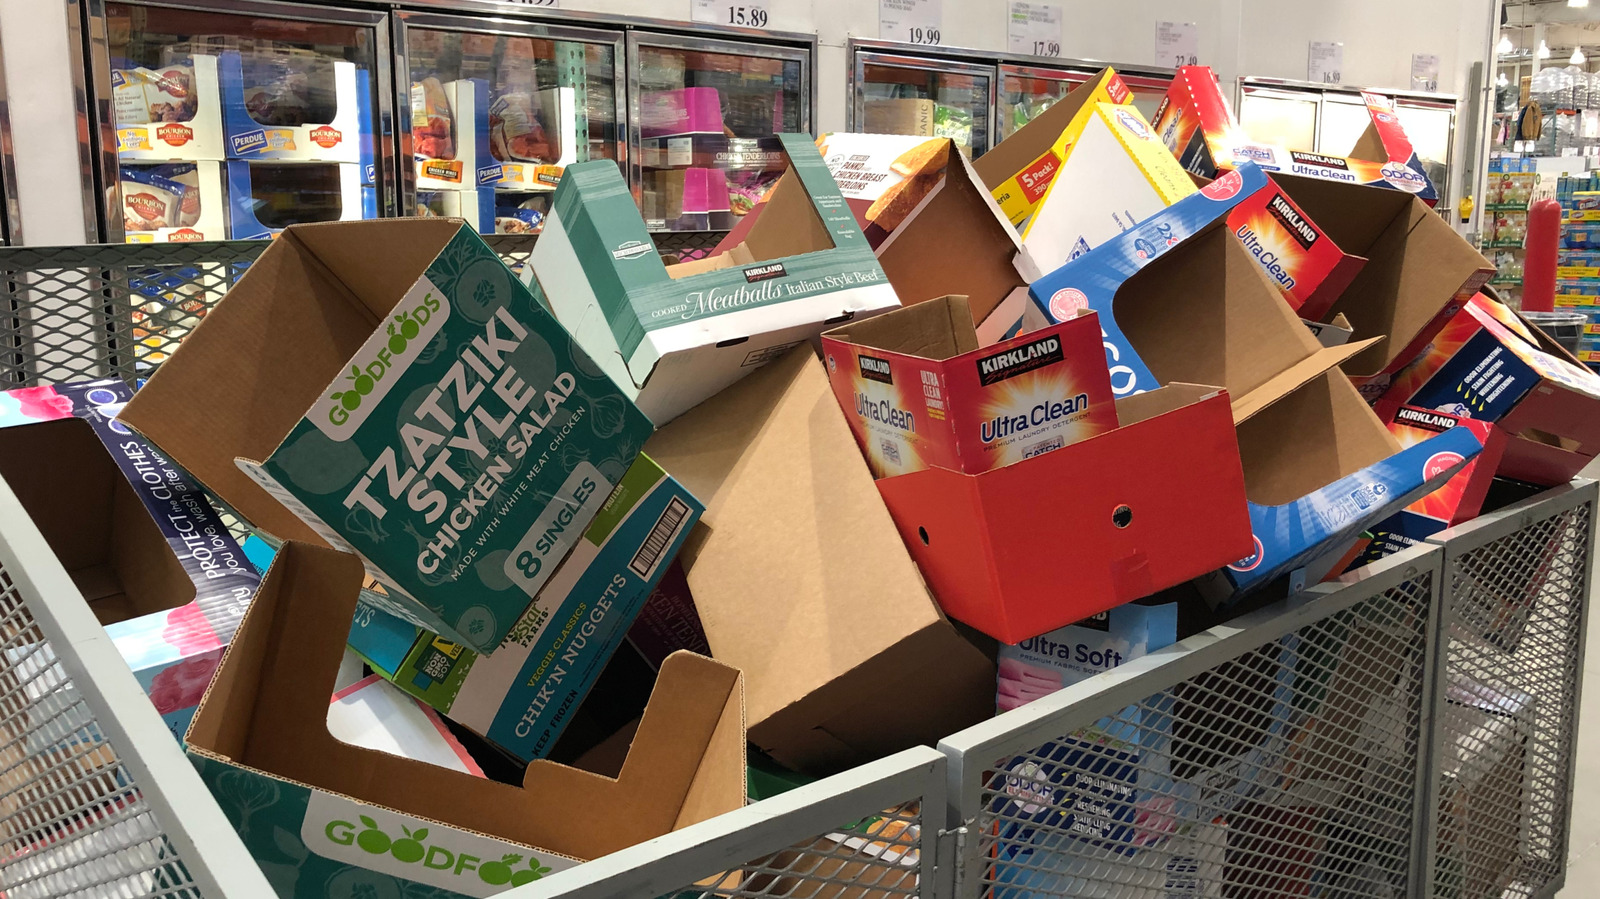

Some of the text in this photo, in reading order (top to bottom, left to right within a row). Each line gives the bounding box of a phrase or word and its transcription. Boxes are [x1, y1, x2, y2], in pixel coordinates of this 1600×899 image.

[728, 6, 768, 27] 15.89
[909, 27, 941, 45] 19.99
[1033, 41, 1060, 57] 17.99
[158, 127, 192, 135] BOURBON
[234, 132, 264, 147] PERDUE
[480, 167, 502, 177] PERDUE
[1293, 152, 1345, 166] KIRKLAND
[834, 170, 888, 182] CHICKEN BREAST
[1022, 162, 1054, 188] 5 Pack!
[1291, 165, 1355, 181] Ultra Clean
[1381, 168, 1424, 182] ODOR
[127, 196, 165, 211] BOURBON
[1272, 196, 1317, 242] KIRKLAND
[1236, 224, 1296, 291] Ultra Clean
[745, 264, 783, 278] KIRKLAND
[651, 268, 879, 319] COOKED Meatballs Italian Style Beef
[328, 292, 440, 427] GOODFOODS
[860, 357, 890, 374] KIRKLAND
[981, 338, 1059, 375] KIRKLAND
[984, 354, 1062, 384] Signature
[1463, 346, 1503, 384] ODOR ELIMINATING
[920, 370, 939, 387] ULTRA
[1471, 359, 1505, 391] STAIN FIGHTING
[1478, 372, 1504, 397] WHITENING
[923, 385, 941, 400] CLEAN
[1485, 375, 1516, 404] BRIGHTENING
[343, 305, 529, 520] TZATZIKI
[854, 391, 916, 434] Ultra Clean
[981, 393, 1088, 443] Ultra Clean
[1398, 408, 1456, 428] KIRKLAND
[407, 365, 536, 524] STYLE
[984, 412, 1092, 452] PREMIUM LAUNDRY DETERGENT
[1033, 438, 1061, 450] PATENTED
[162, 467, 187, 492] after
[417, 372, 576, 575] CHICKEN SALAD
[451, 406, 586, 581] MADE WITH WHITE MEAT CHICKEN
[119, 441, 226, 579] PROTECT the CLOTHES
[182, 494, 208, 523] wash
[204, 524, 228, 551] love,
[516, 476, 596, 579] 8 SINGLES
[1389, 532, 1403, 543] ODOR
[1385, 543, 1398, 552] STAIN
[221, 552, 247, 574] you
[521, 611, 549, 648] FARMS
[515, 665, 567, 738] CHIK'N
[562, 573, 627, 665] NUGGETS
[527, 602, 587, 688] VEGGIE CLASSICS
[1020, 637, 1123, 668] Ultra Soft
[425, 652, 441, 674] NON
[430, 656, 447, 677] GMO
[437, 661, 450, 679] SOY
[1020, 653, 1051, 665] PREMIUM
[1054, 661, 1080, 672] FABRIC
[531, 689, 579, 756] KEEP FROZEN
[324, 816, 546, 888] GOODFOO
